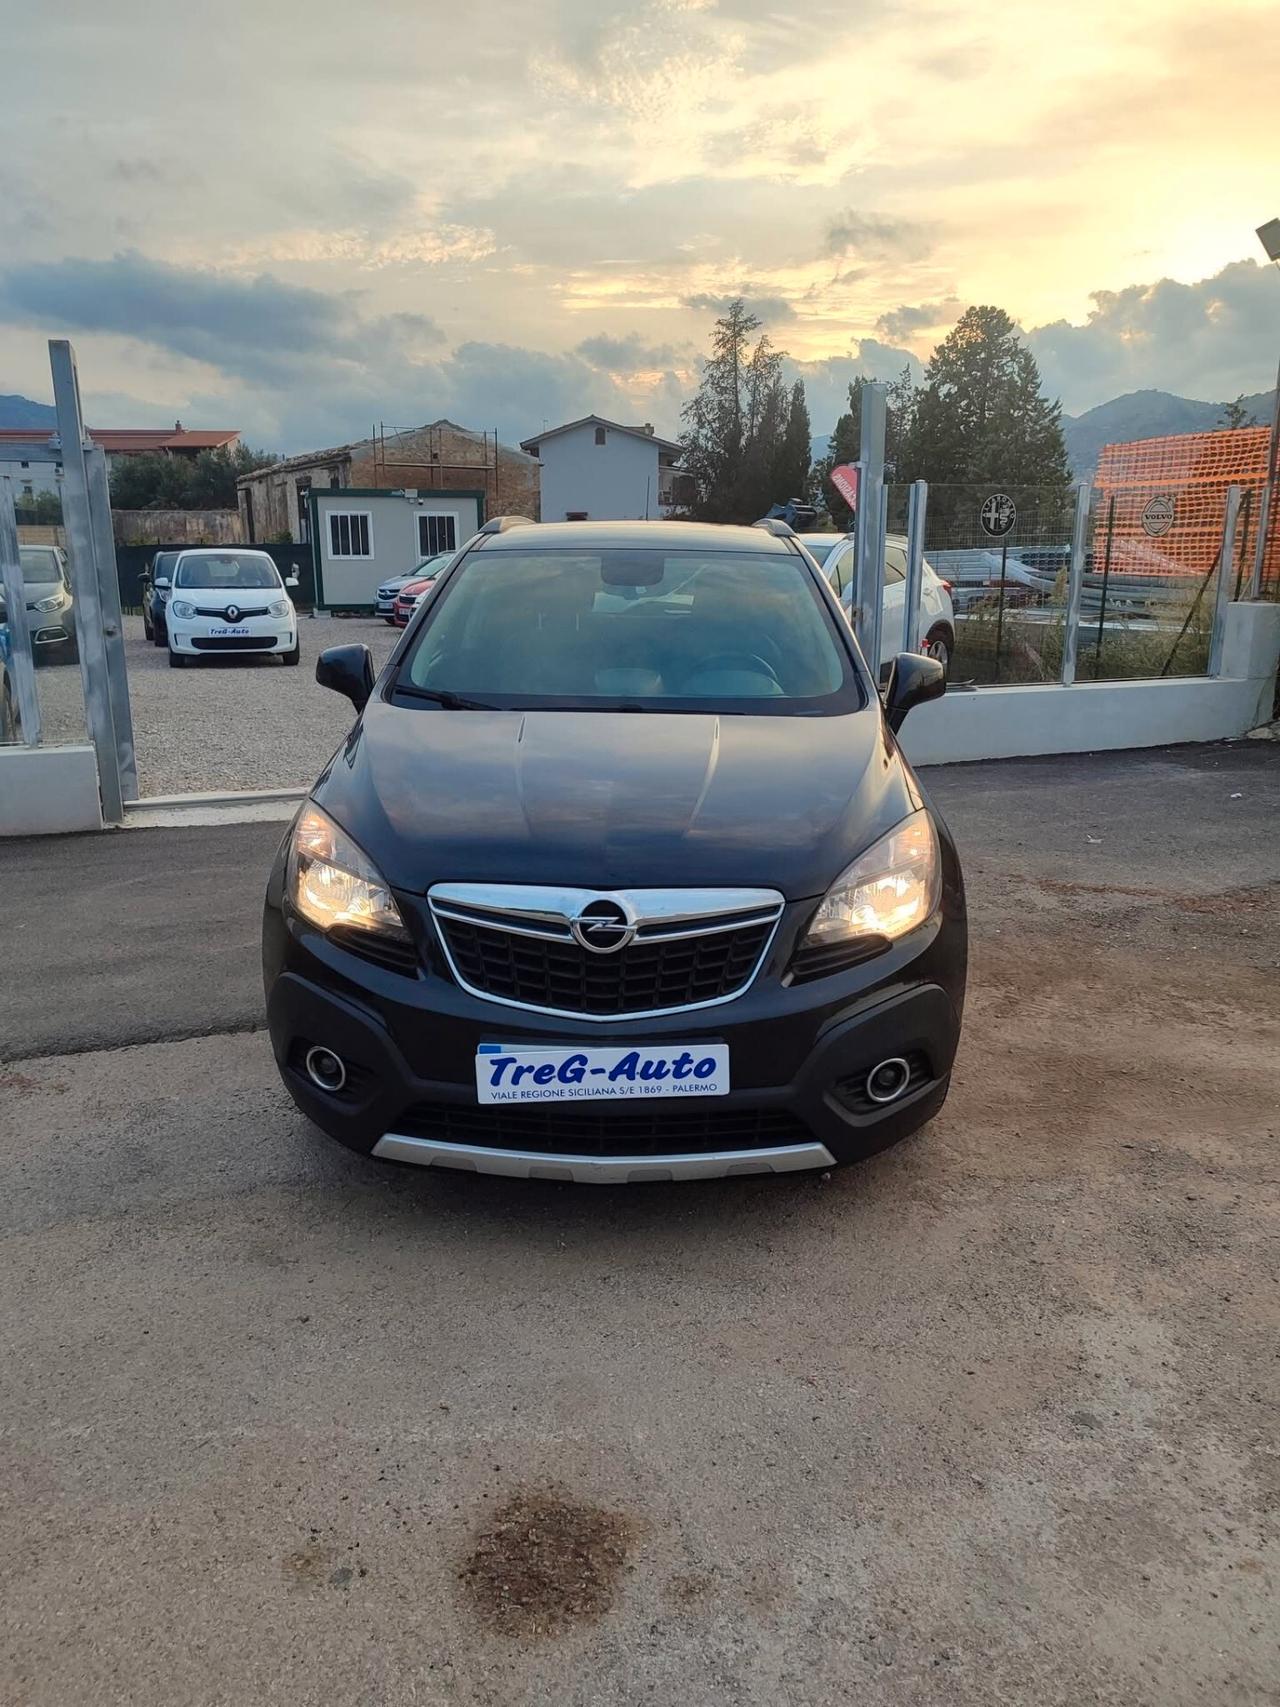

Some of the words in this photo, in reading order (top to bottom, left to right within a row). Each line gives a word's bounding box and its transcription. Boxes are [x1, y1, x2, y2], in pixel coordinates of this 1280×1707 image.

[489, 1051, 717, 1087] TreG-Auto
[491, 1091, 518, 1100] VIALE
[520, 1089, 566, 1099] REGIONE
[568, 1087, 617, 1097] SICILIANA
[619, 1086, 635, 1096] S/E
[639, 1085, 662, 1094] 1869
[672, 1083, 718, 1093] PALERMO
